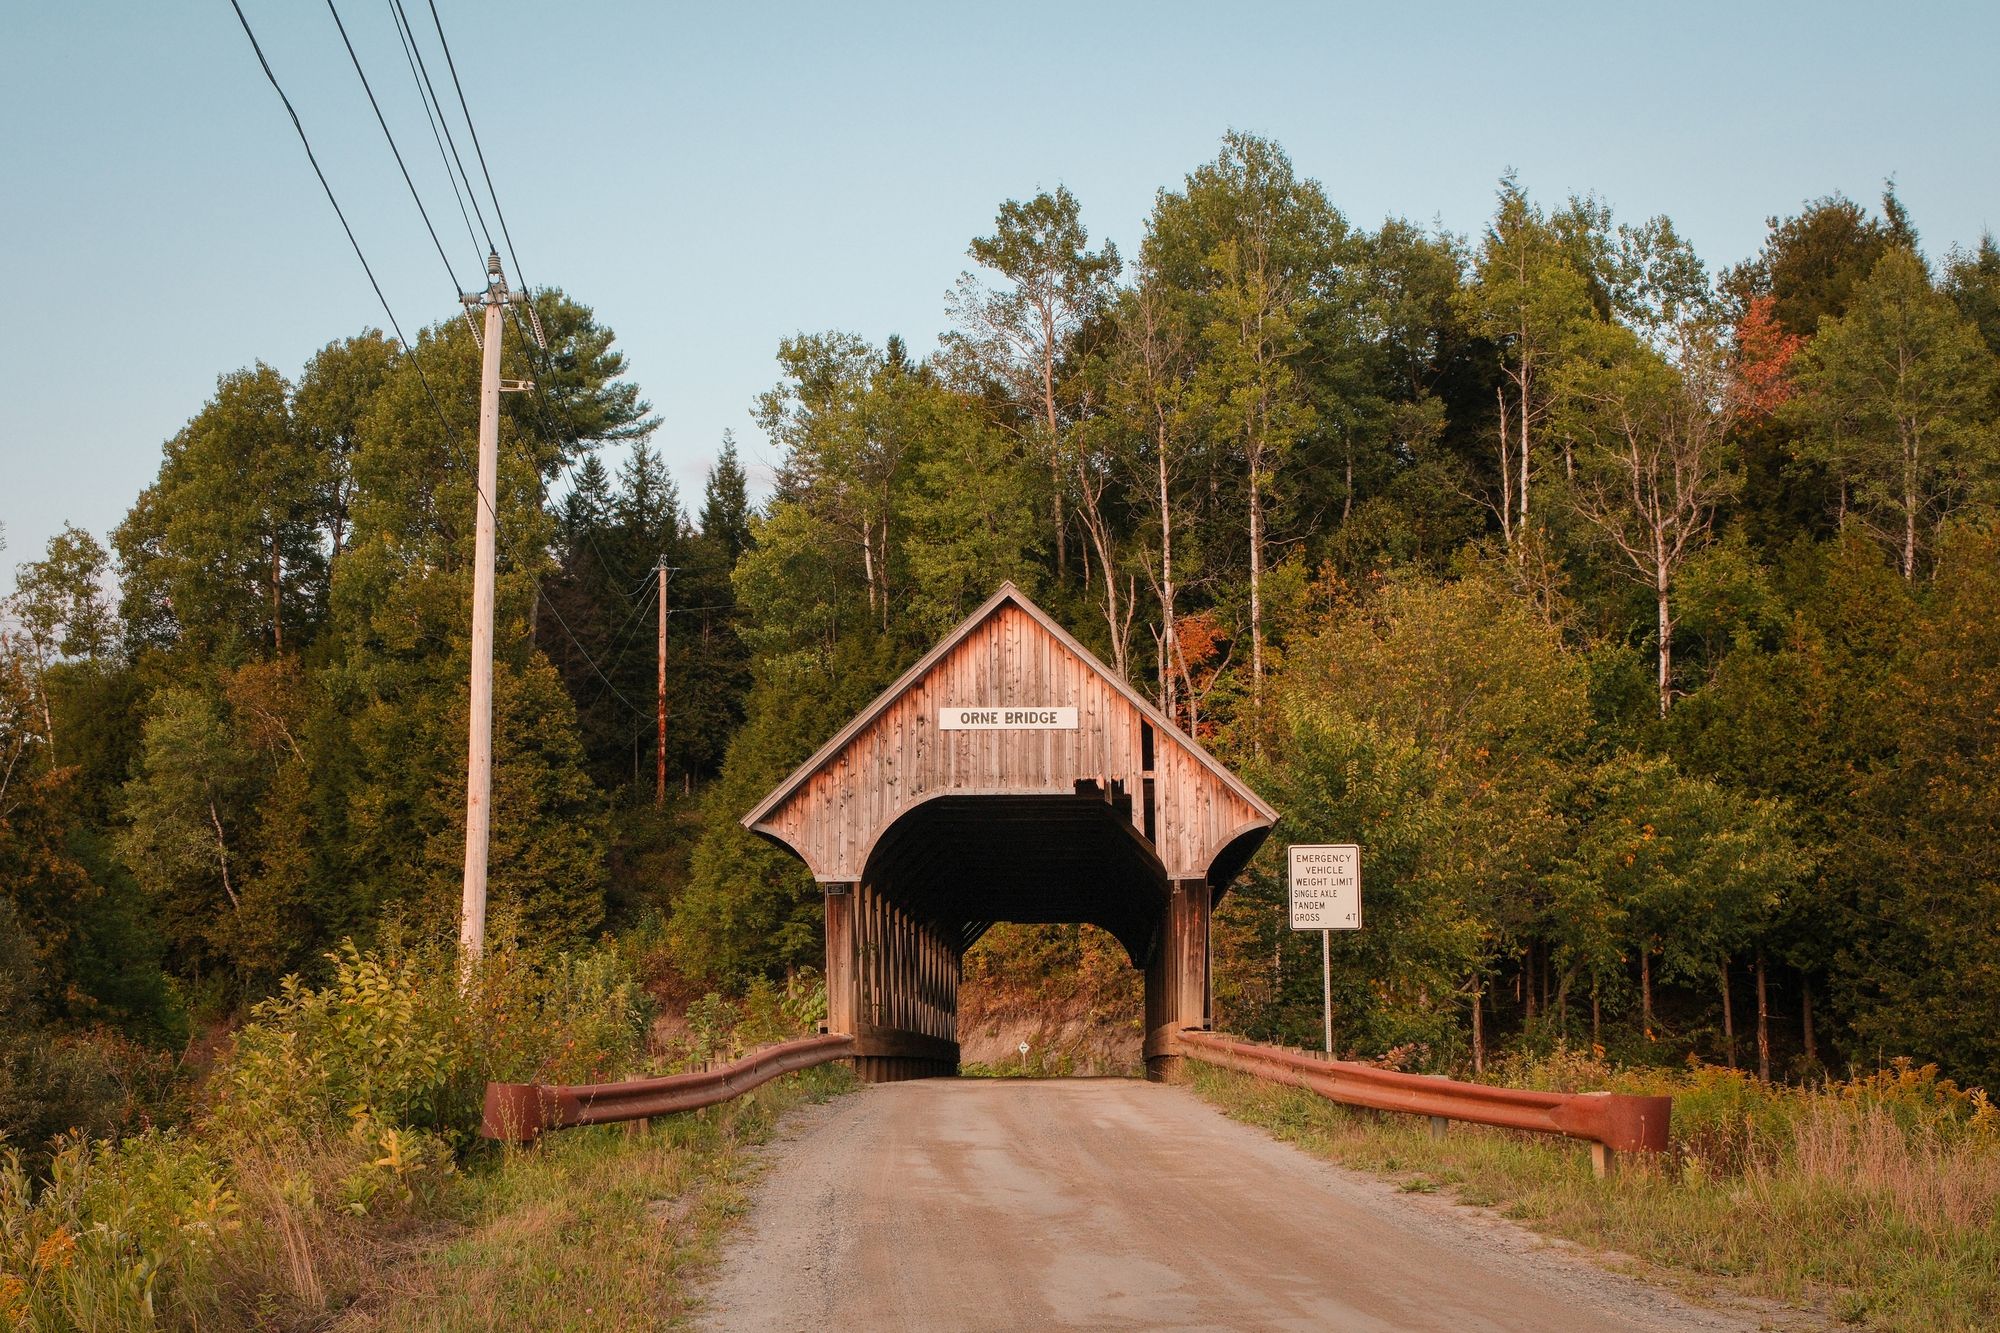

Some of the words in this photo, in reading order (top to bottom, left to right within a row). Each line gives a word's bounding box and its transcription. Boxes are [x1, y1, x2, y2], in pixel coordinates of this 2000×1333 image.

[960, 712, 998, 724] ORNE
[1005, 711, 1057, 724] BRIDGE
[1296, 854, 1351, 863] EMERGENCY
[1305, 866, 1344, 874] VEHICLE
[1295, 878, 1328, 886] WEIGHT
[1331, 878, 1353, 886] LIMIT
[1294, 890, 1318, 898] SINGLE
[1320, 890, 1337, 898] AXLE
[1294, 901, 1325, 910] TANDEM
[1294, 913, 1320, 921] GROSS
